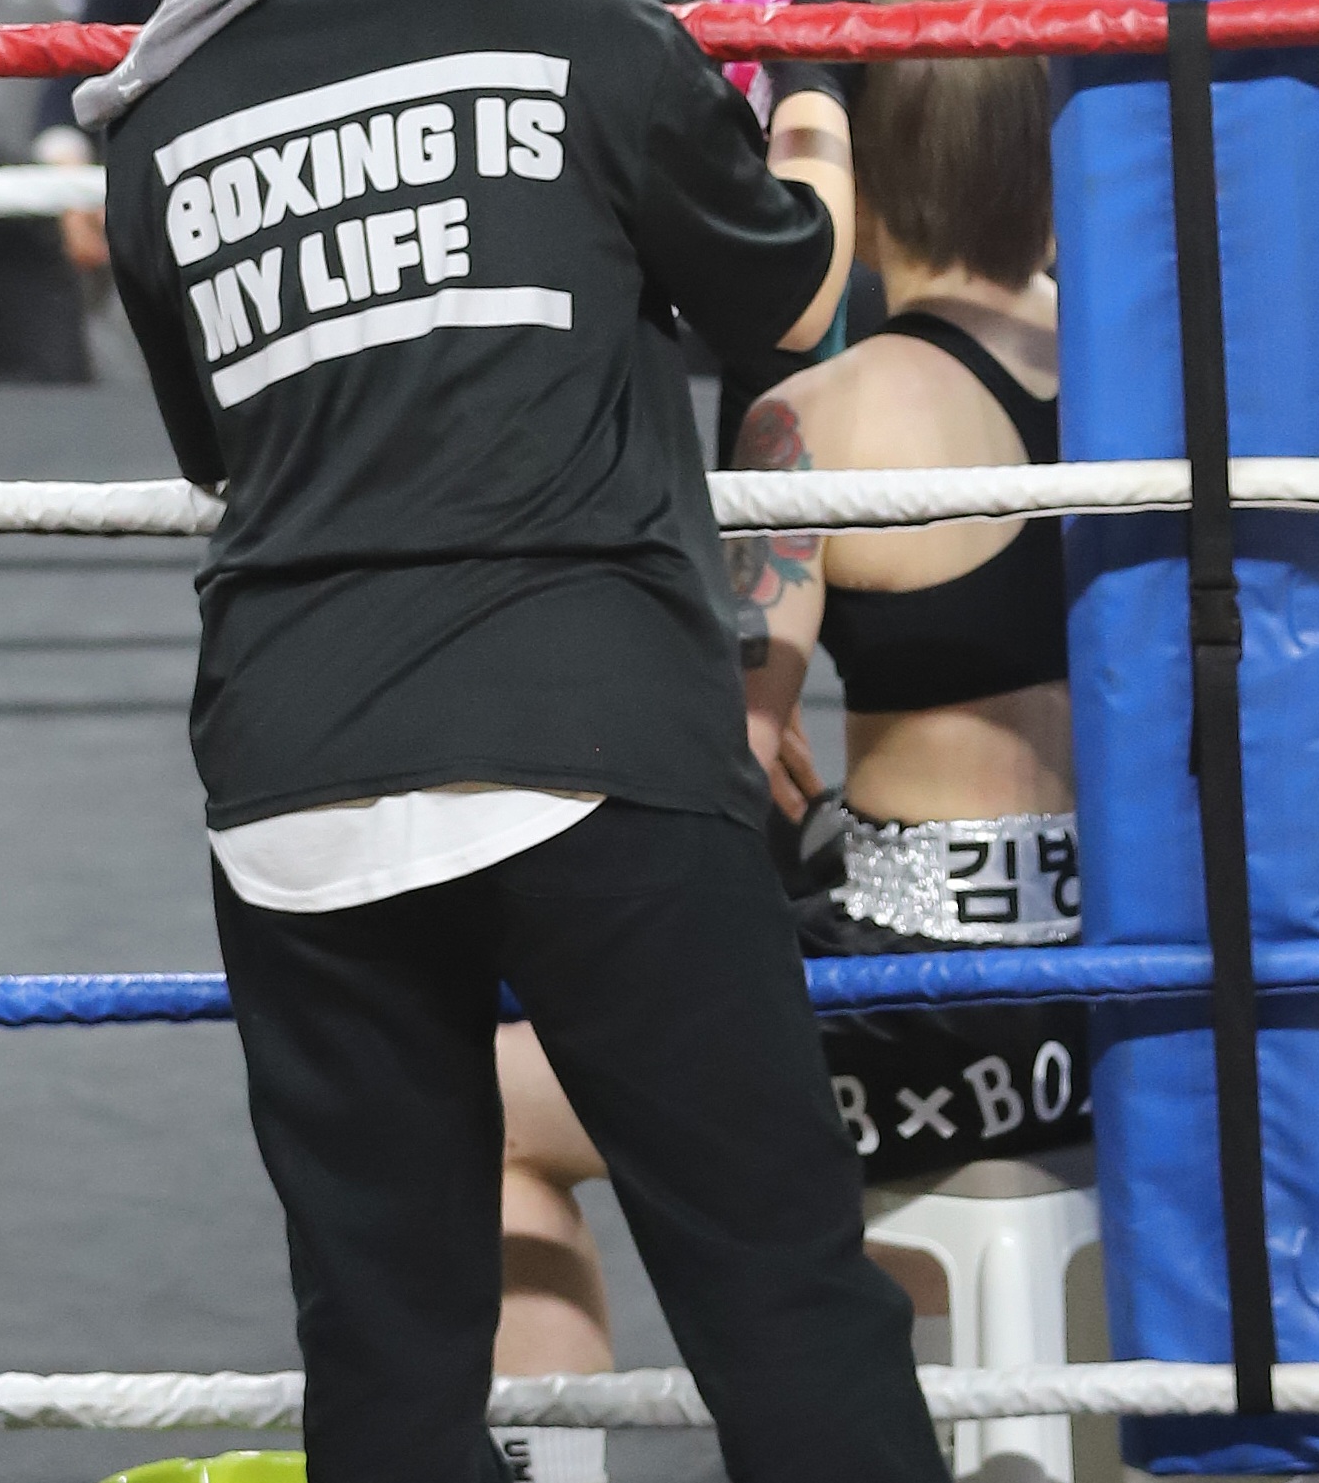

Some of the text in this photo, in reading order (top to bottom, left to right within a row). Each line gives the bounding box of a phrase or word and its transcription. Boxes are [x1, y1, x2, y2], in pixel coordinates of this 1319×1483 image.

[166, 96, 566, 268] BOXING IS
[188, 196, 471, 363] MY LIFE
